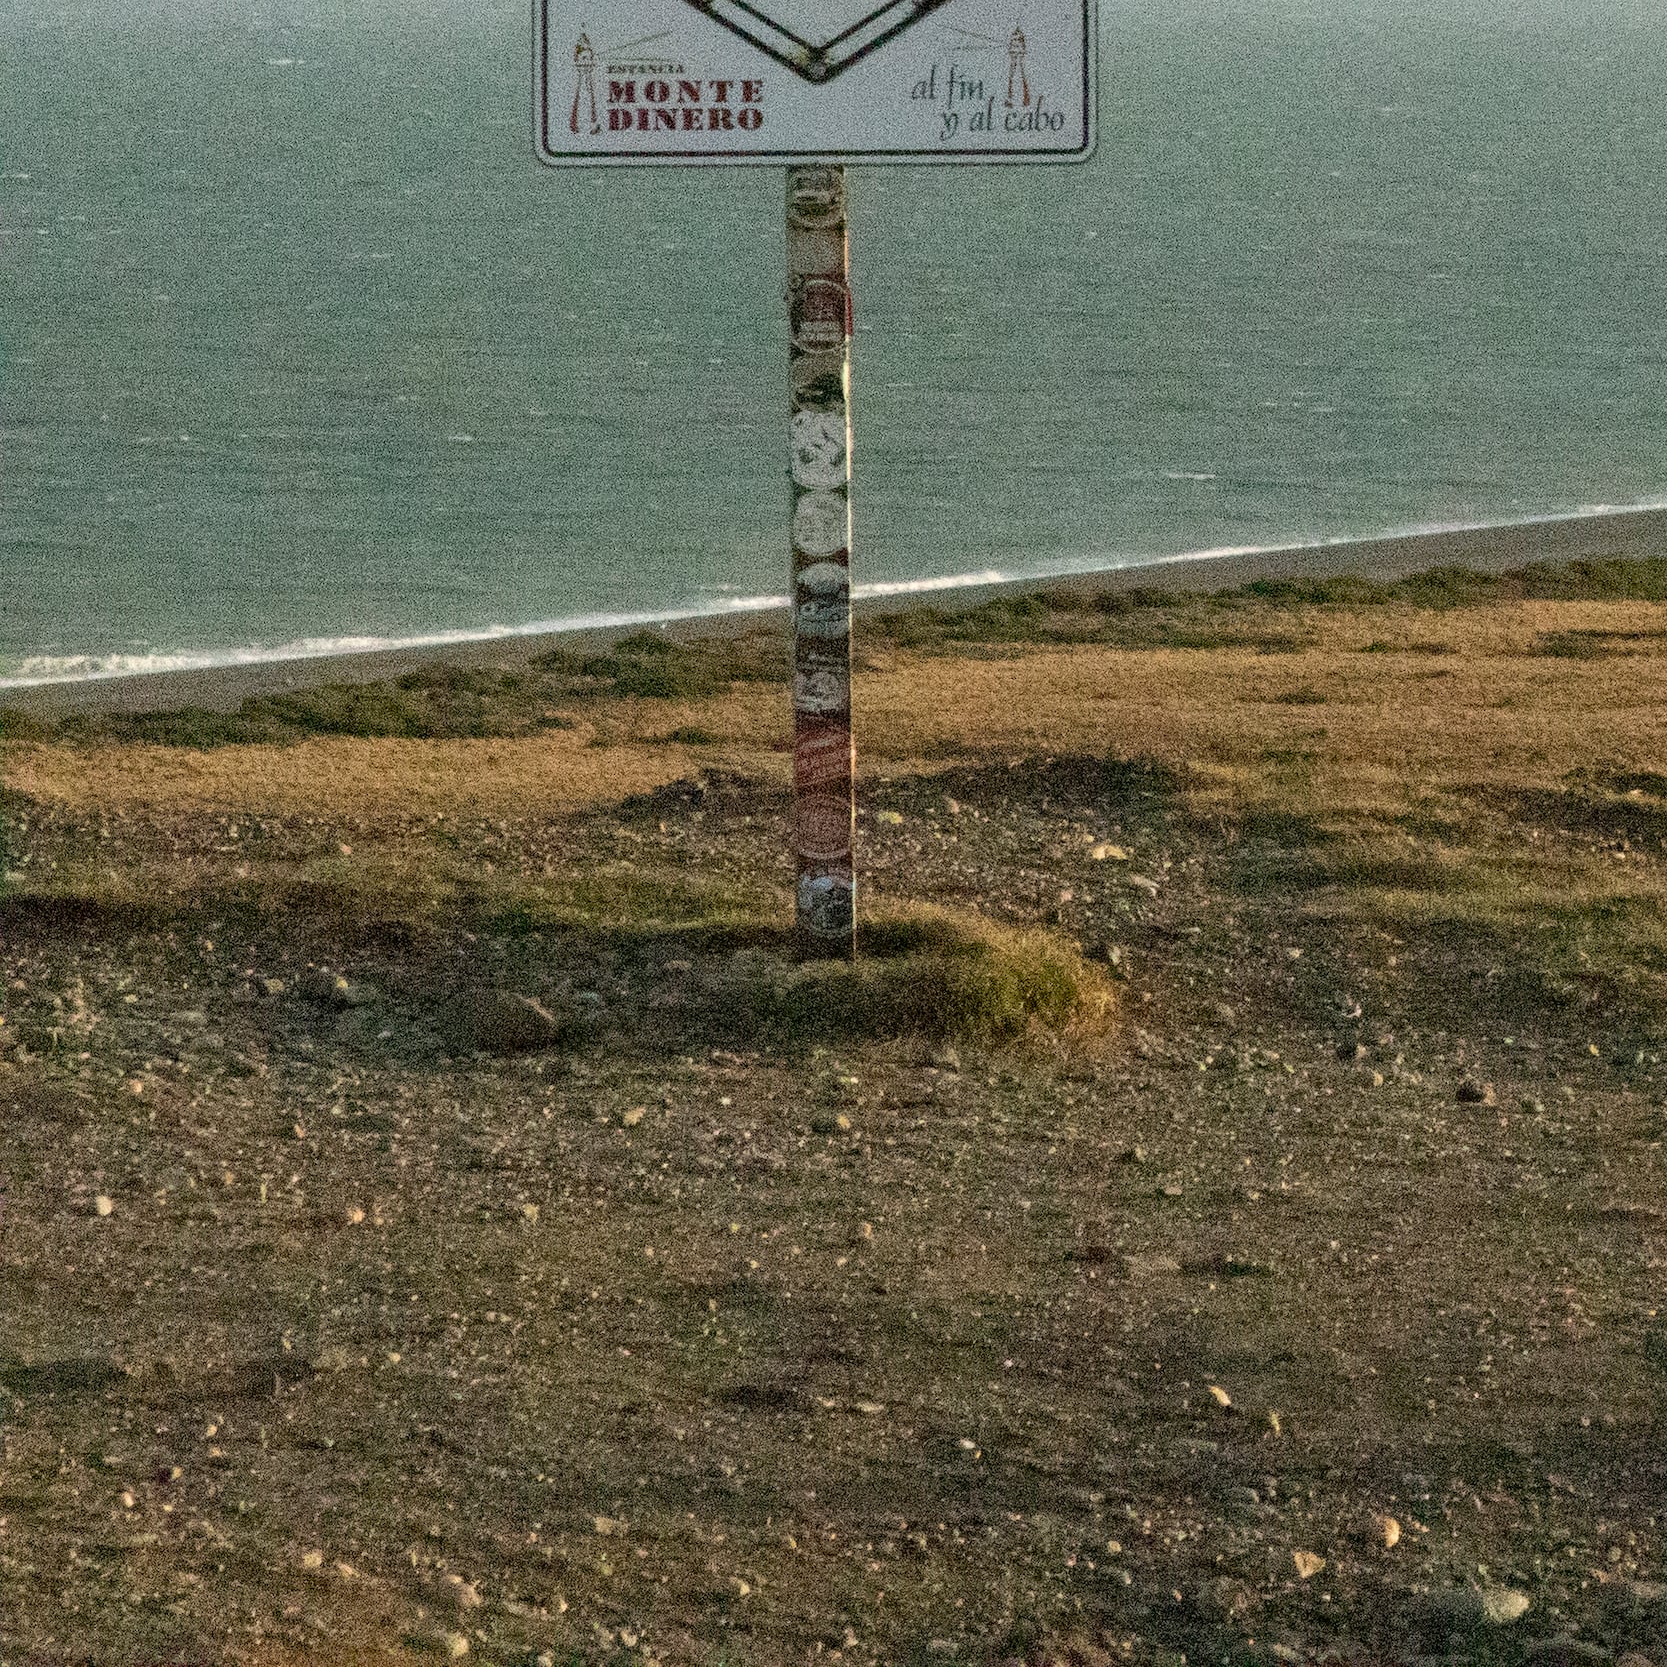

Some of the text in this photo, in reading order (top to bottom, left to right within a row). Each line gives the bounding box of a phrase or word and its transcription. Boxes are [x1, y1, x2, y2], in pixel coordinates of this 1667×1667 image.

[607, 65, 686, 75] ESTANCIA
[608, 80, 764, 103] MONTE
[912, 64, 984, 110] al fin
[608, 108, 764, 131] DINERO
[939, 95, 1065, 142] y al cabo
